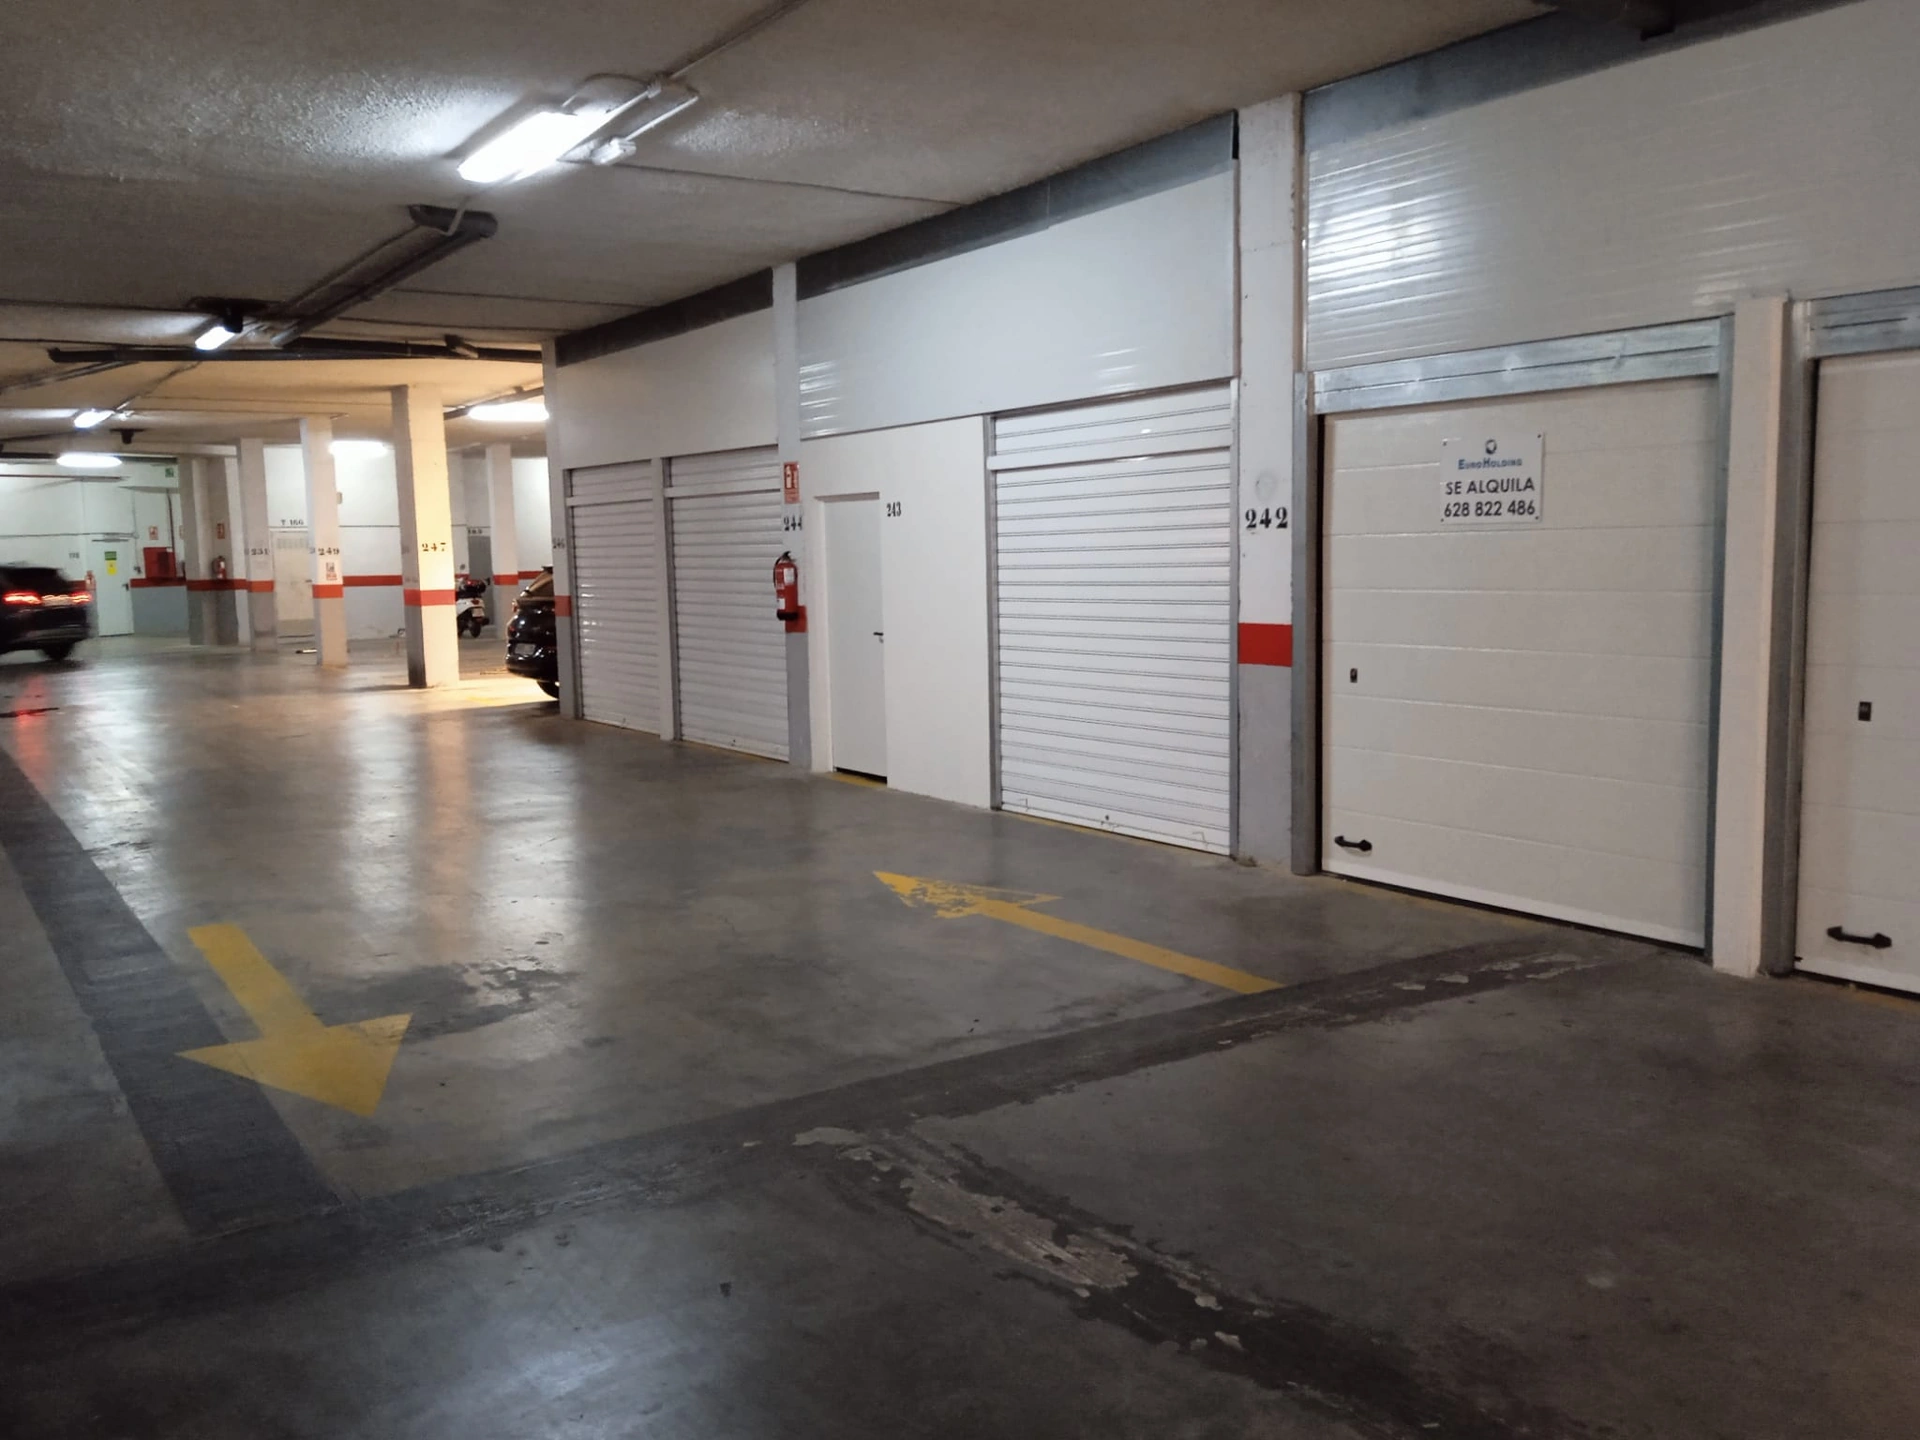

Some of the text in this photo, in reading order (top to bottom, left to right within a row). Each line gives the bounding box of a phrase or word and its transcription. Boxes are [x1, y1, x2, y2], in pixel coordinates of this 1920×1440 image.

[1445, 477, 1535, 495] SE ALQUILA
[886, 501, 902, 517] 243
[1444, 500, 1535, 517] 628 822 486
[783, 515, 803, 531] 244
[1245, 506, 1288, 529] 242
[421, 542, 446, 552] 247
